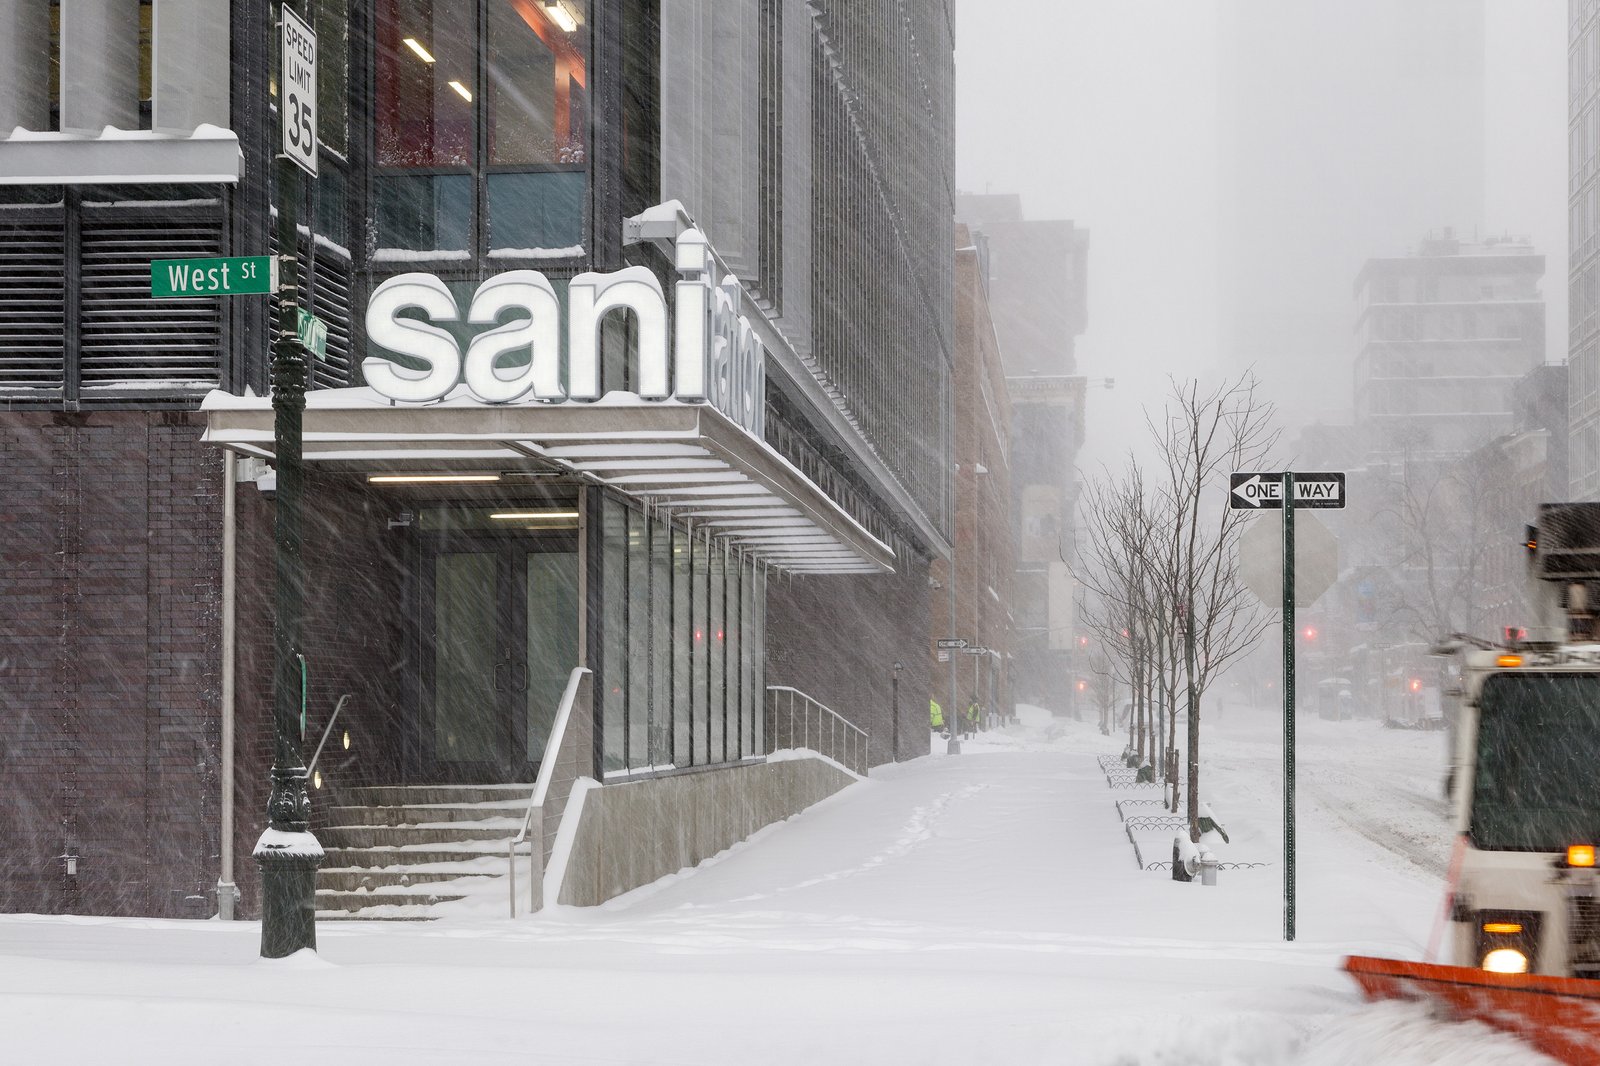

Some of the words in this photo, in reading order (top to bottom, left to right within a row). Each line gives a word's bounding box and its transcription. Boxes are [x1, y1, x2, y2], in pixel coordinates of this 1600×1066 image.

[286, 23, 314, 65] SPEED
[289, 56, 311, 94] LIMIT
[288, 92, 313, 157] 35
[168, 262, 230, 292] West
[241, 261, 257, 279] St
[1245, 483, 1279, 498] ONE
[1298, 483, 1335, 498] WAY
